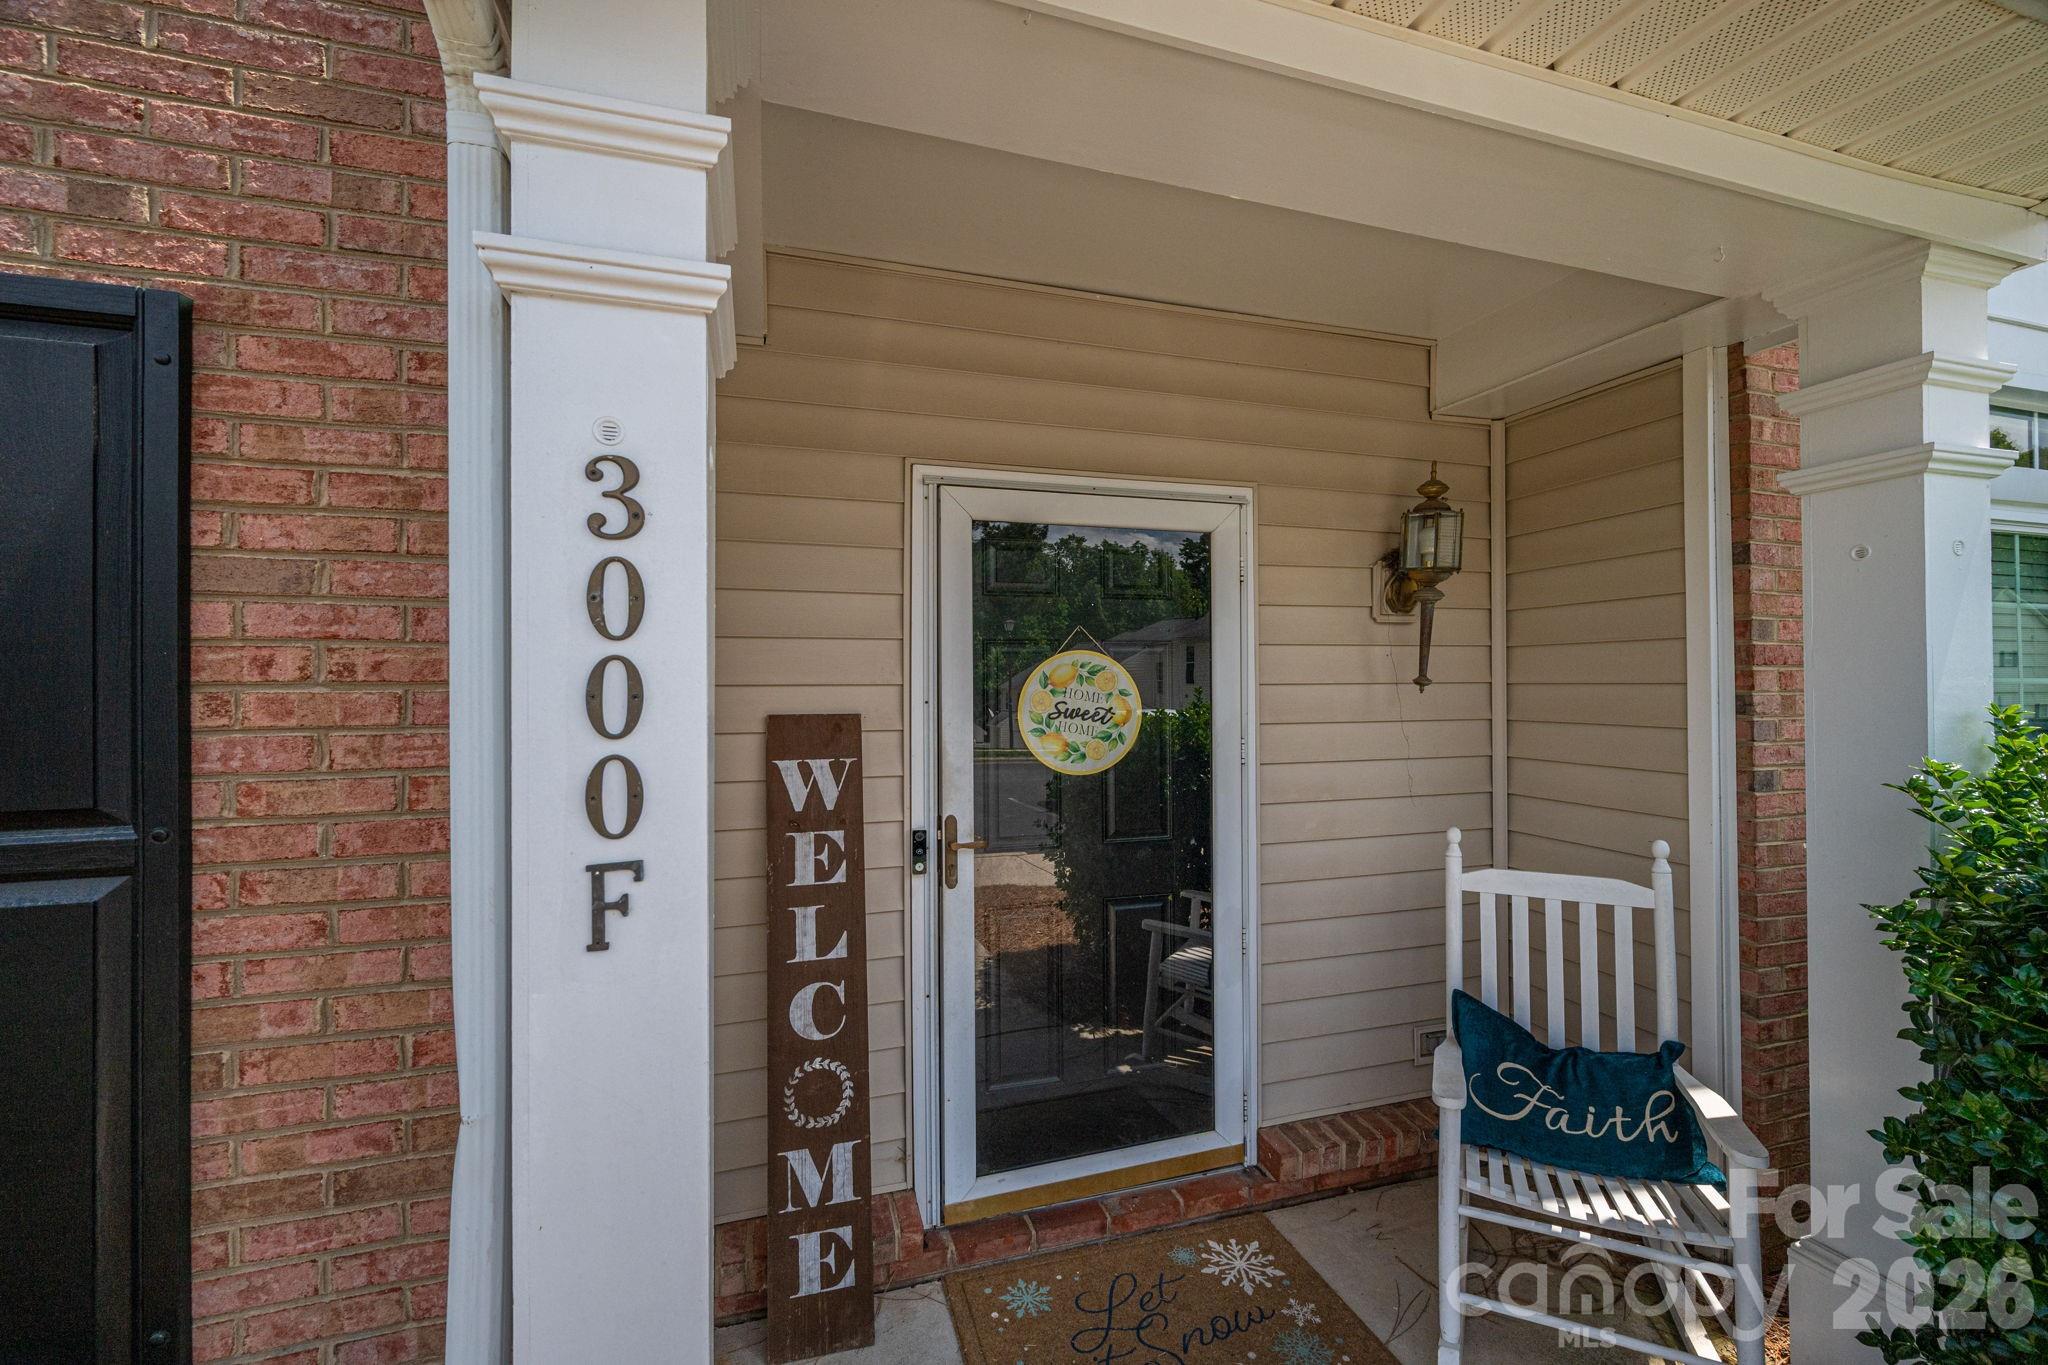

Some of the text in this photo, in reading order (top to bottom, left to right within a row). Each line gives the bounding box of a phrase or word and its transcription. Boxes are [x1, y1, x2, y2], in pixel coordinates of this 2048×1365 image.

[1048, 700, 1116, 725] Sweet
[1063, 687, 1105, 703] HOME
[1057, 720, 1099, 737] HOME
[771, 758, 862, 1300] WELCOME
[1469, 1061, 1679, 1144] Faith
[1071, 1273, 1185, 1353] Let
[1136, 1305, 1276, 1365] Snow
